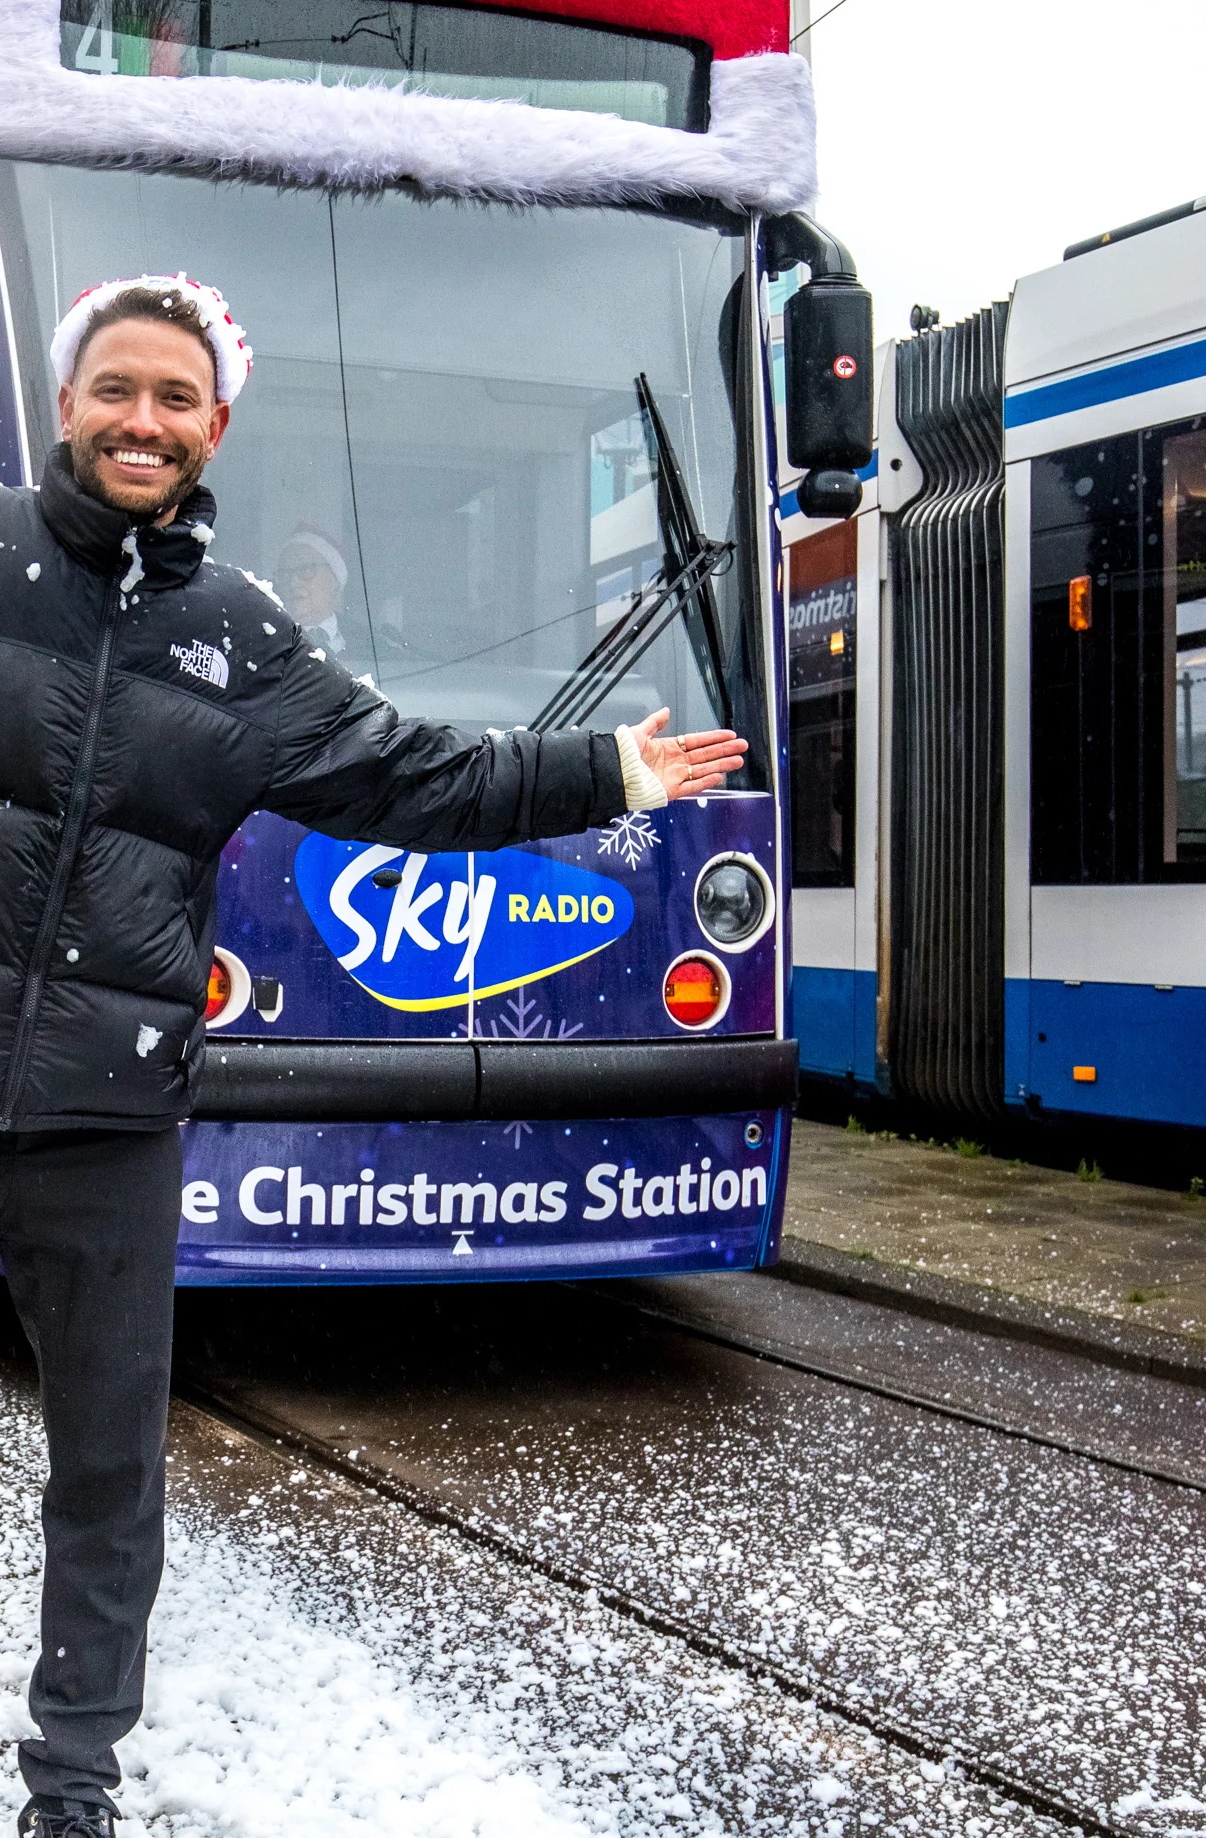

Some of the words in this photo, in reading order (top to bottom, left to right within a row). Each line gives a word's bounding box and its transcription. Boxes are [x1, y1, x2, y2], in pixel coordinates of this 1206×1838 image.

[75, 0, 119, 75] 4
[170, 644, 212, 669] NORTH
[180, 659, 210, 681] FACE
[192, 639, 214, 659] THE
[328, 843, 497, 982] Sky
[508, 893, 615, 924] RADIO
[238, 1166, 568, 1226] Christmas
[583, 1157, 768, 1223] Station
